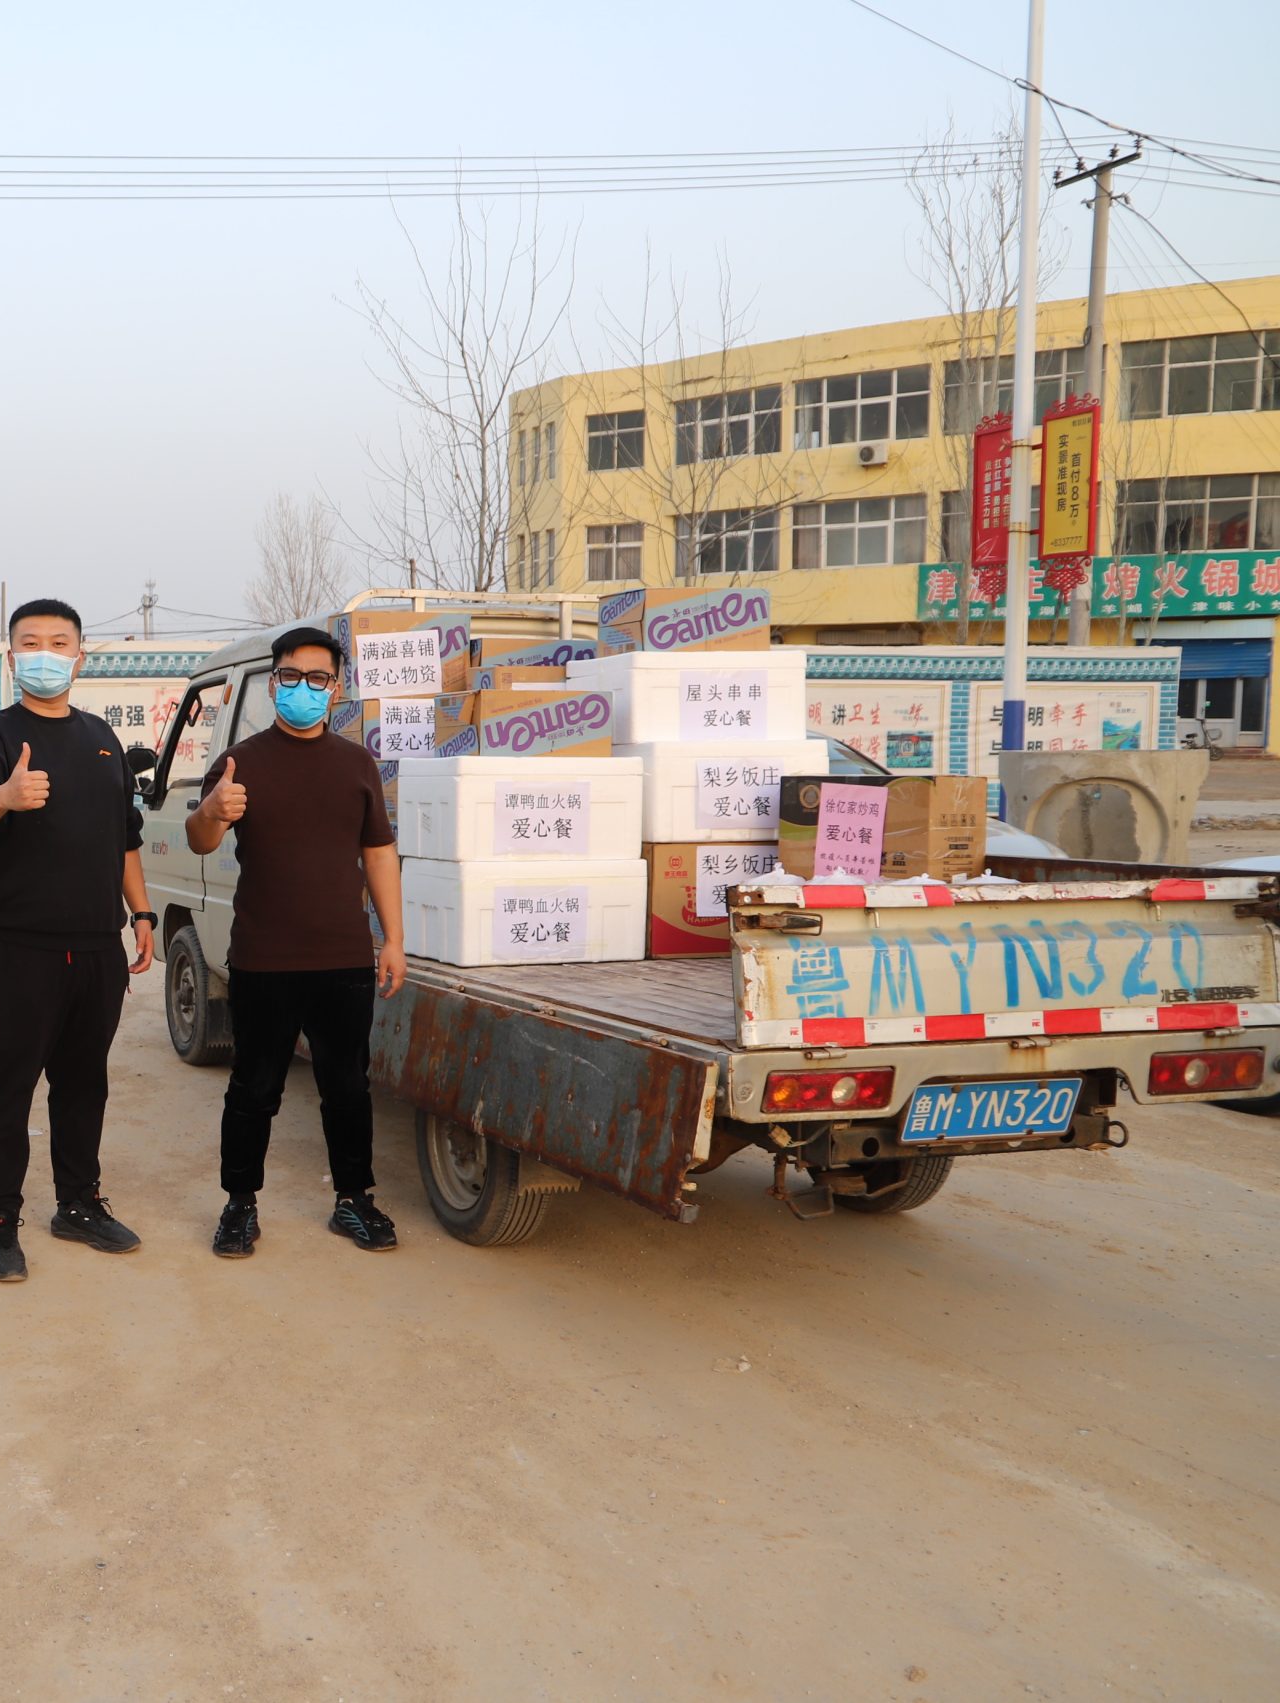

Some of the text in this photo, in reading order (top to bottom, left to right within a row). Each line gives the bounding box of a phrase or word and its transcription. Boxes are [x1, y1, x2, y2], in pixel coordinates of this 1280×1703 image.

[927, 557, 1280, 605] 津烤火锅城
[362, 638, 436, 661] 满溢喜铺
[363, 664, 437, 688] 爱心物资
[686, 683, 762, 702] 屋头串串
[703, 709, 752, 727] 爱心餐
[989, 702, 1088, 728] 与明牵手
[702, 766, 780, 788] 梨乡饭庄
[504, 793, 582, 810] 谭鸭血火锅
[713, 796, 772, 817] 爱心餐
[825, 799, 880, 818] 徐亿家炒鸡
[511, 817, 573, 839] 爱心餐
[826, 824, 873, 845] 爱心餐
[701, 854, 779, 876] 梨乡饭庄
[503, 898, 579, 914] 谭鸭血火锅
[510, 921, 571, 944] 爱心餐
